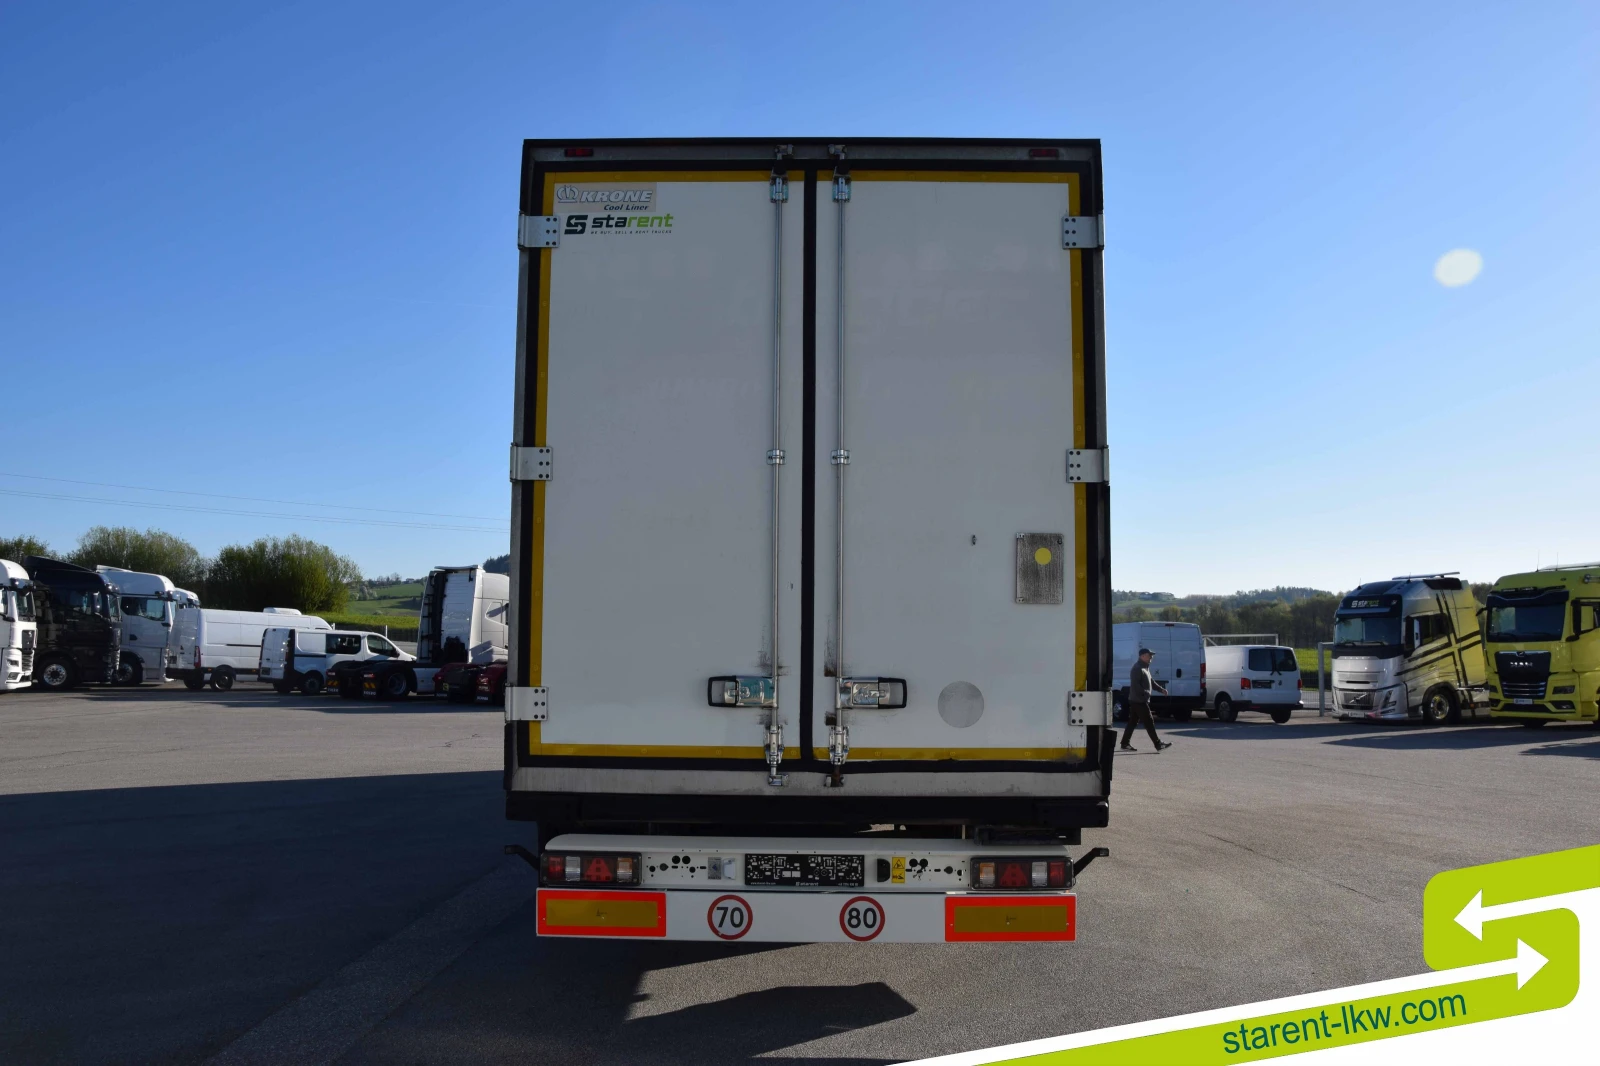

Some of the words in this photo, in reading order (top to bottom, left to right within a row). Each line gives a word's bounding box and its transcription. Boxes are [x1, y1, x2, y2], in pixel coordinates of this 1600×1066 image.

[579, 190, 653, 203] KRONE
[591, 213, 674, 228] starent
[716, 906, 745, 929] 70
[847, 907, 877, 929] 80
